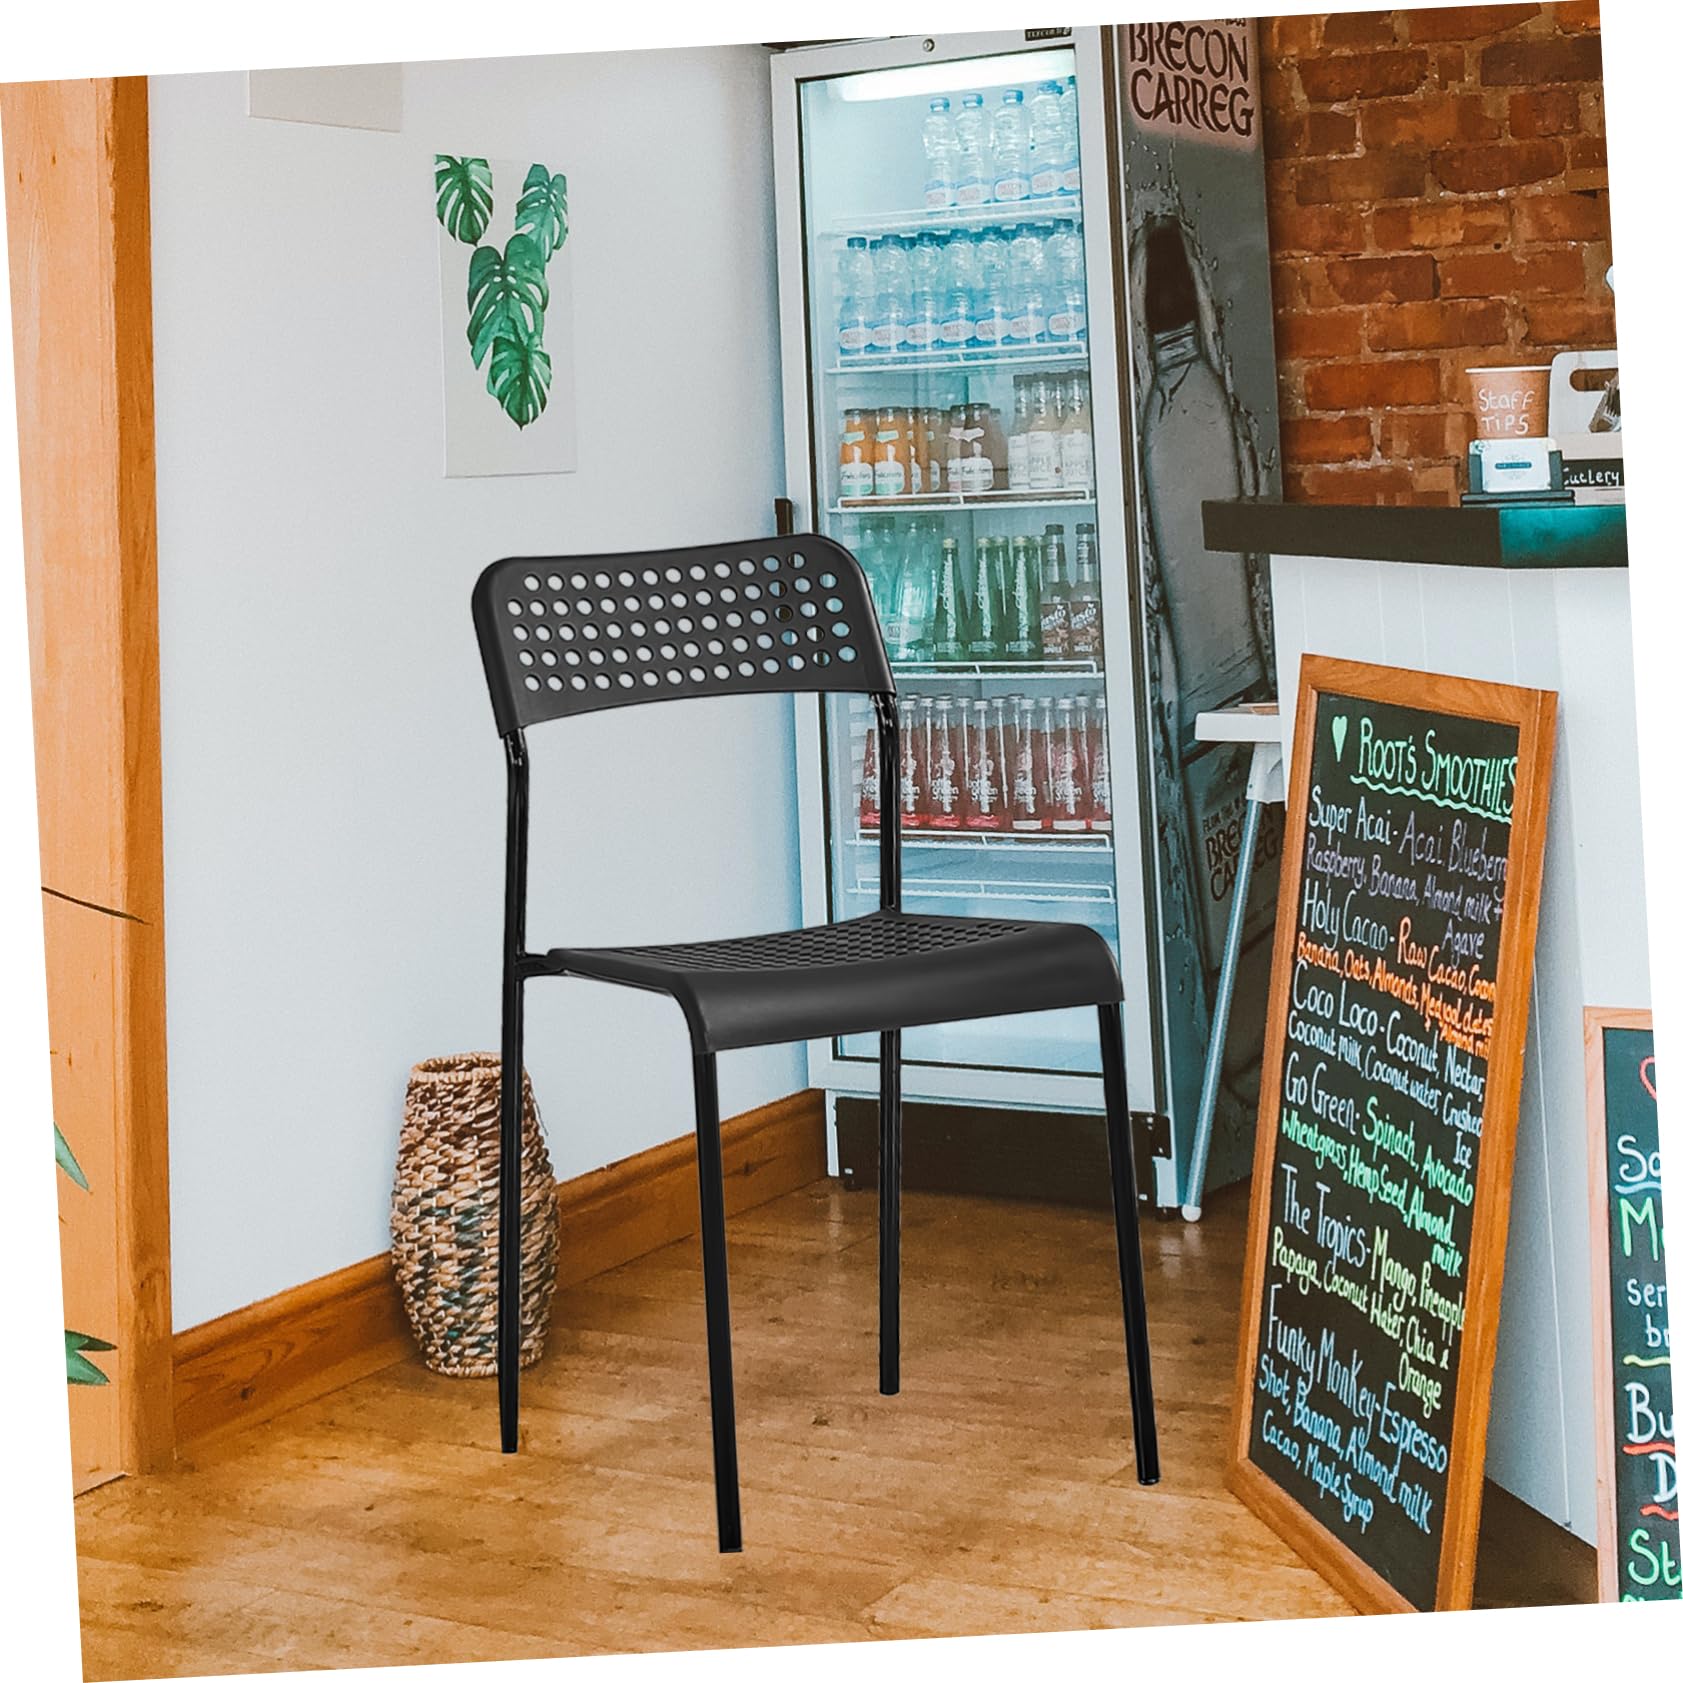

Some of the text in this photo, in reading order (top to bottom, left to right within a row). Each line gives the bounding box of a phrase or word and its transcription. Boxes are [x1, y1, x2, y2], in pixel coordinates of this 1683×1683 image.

[1129, 22, 1249, 82] BRECON
[1130, 68, 1254, 136] CARREG
[1478, 389, 1535, 412] Staff
[1308, 785, 1352, 845] Super
[1302, 878, 1341, 951] Holy
[1397, 917, 1428, 969] Raw
[1441, 918, 1485, 969] Agave
[1293, 963, 1334, 1019] Coco
[1288, 1010, 1336, 1056] Coconut
[1365, 1045, 1409, 1096] Coconut
[1285, 1051, 1308, 1106] Go
[1420, 1145, 1474, 1207] Avocado
[1453, 1131, 1473, 1169] Ice
[1281, 1163, 1310, 1235] The
[1619, 1197, 1665, 1262] M
[1323, 1260, 1369, 1314] Coconut
[1432, 1243, 1463, 1278] milk
[1268, 1284, 1316, 1396] Funky
[1379, 1381, 1448, 1476] Espresso
[1399, 1352, 1443, 1419] Orange
[1304, 1442, 1341, 1499] Maple
[1341, 1472, 1374, 1535] Syrup
[1398, 1481, 1432, 1534] milk
